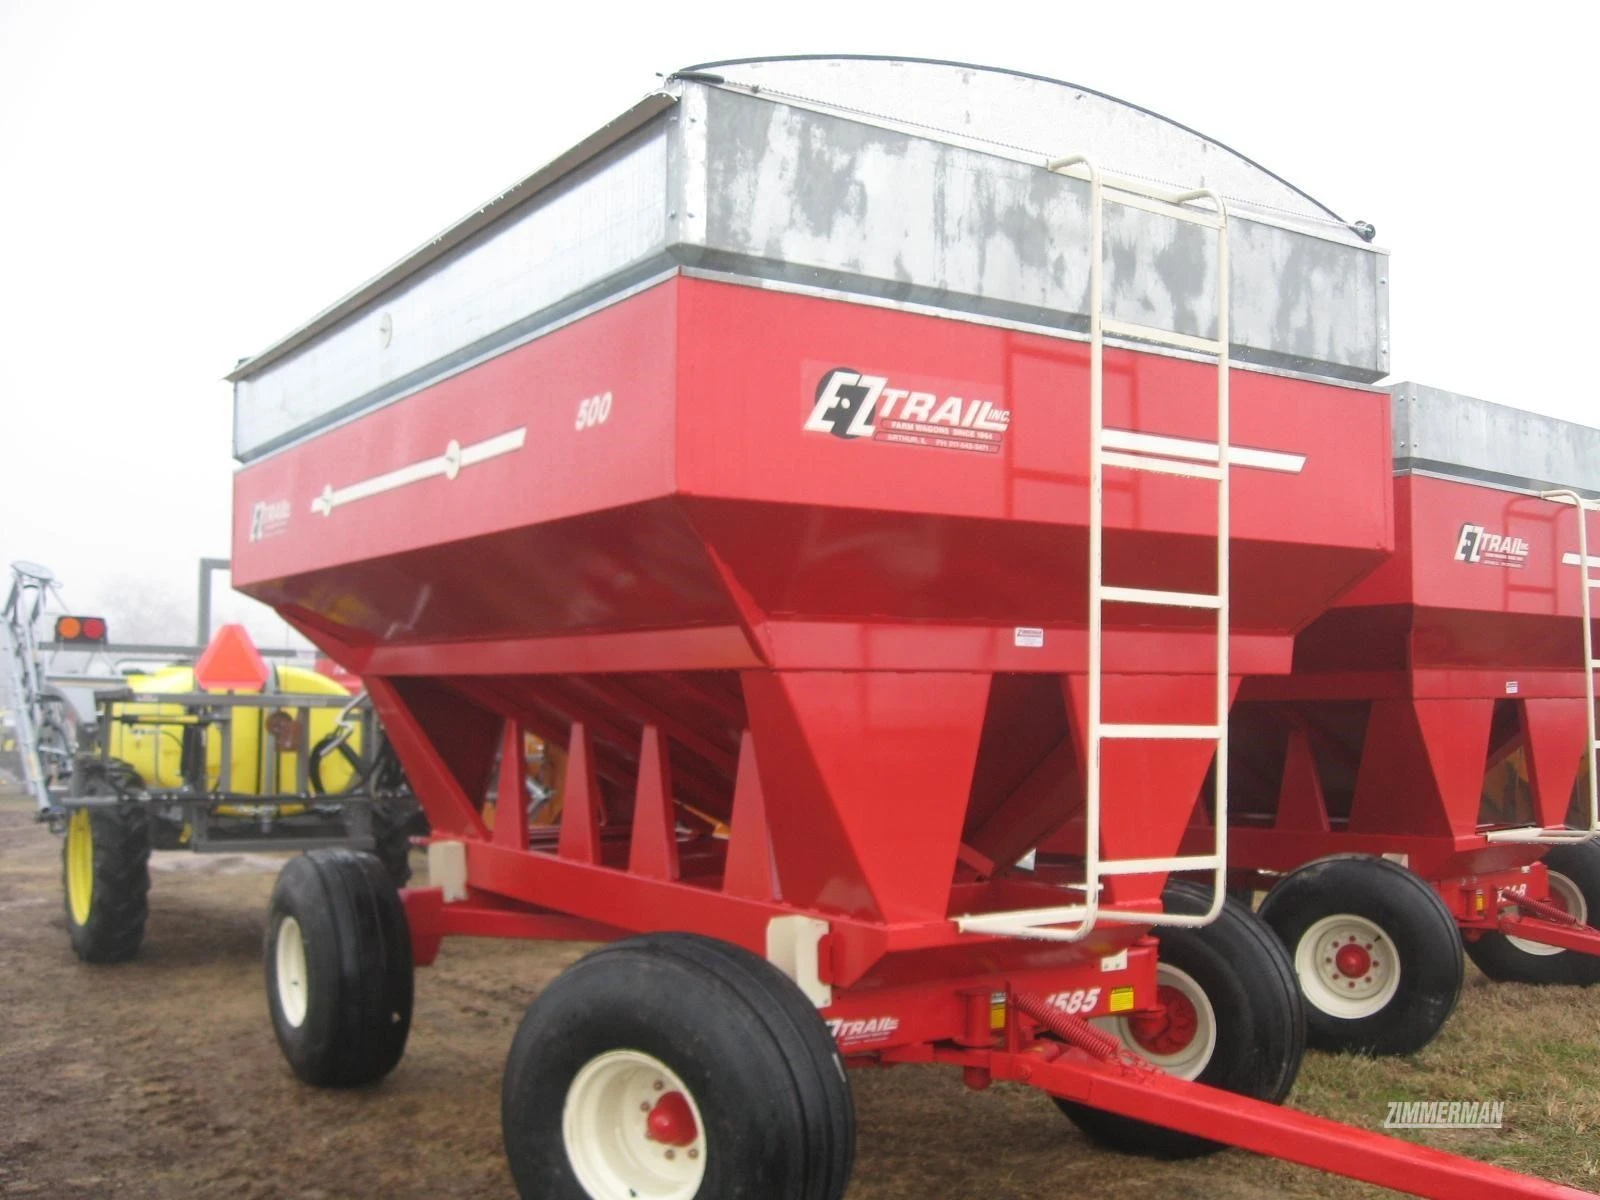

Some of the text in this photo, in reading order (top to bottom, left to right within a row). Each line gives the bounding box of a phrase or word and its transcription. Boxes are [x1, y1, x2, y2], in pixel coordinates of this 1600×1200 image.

[575, 391, 612, 431] 500
[879, 388, 1009, 432] TRAIL
[891, 421, 914, 431] FARM
[915, 423, 950, 435] WAGONS
[952, 428, 976, 438] SINCE
[1481, 533, 1529, 556] TRAIL
[839, 1017, 898, 1036] TRAIL
